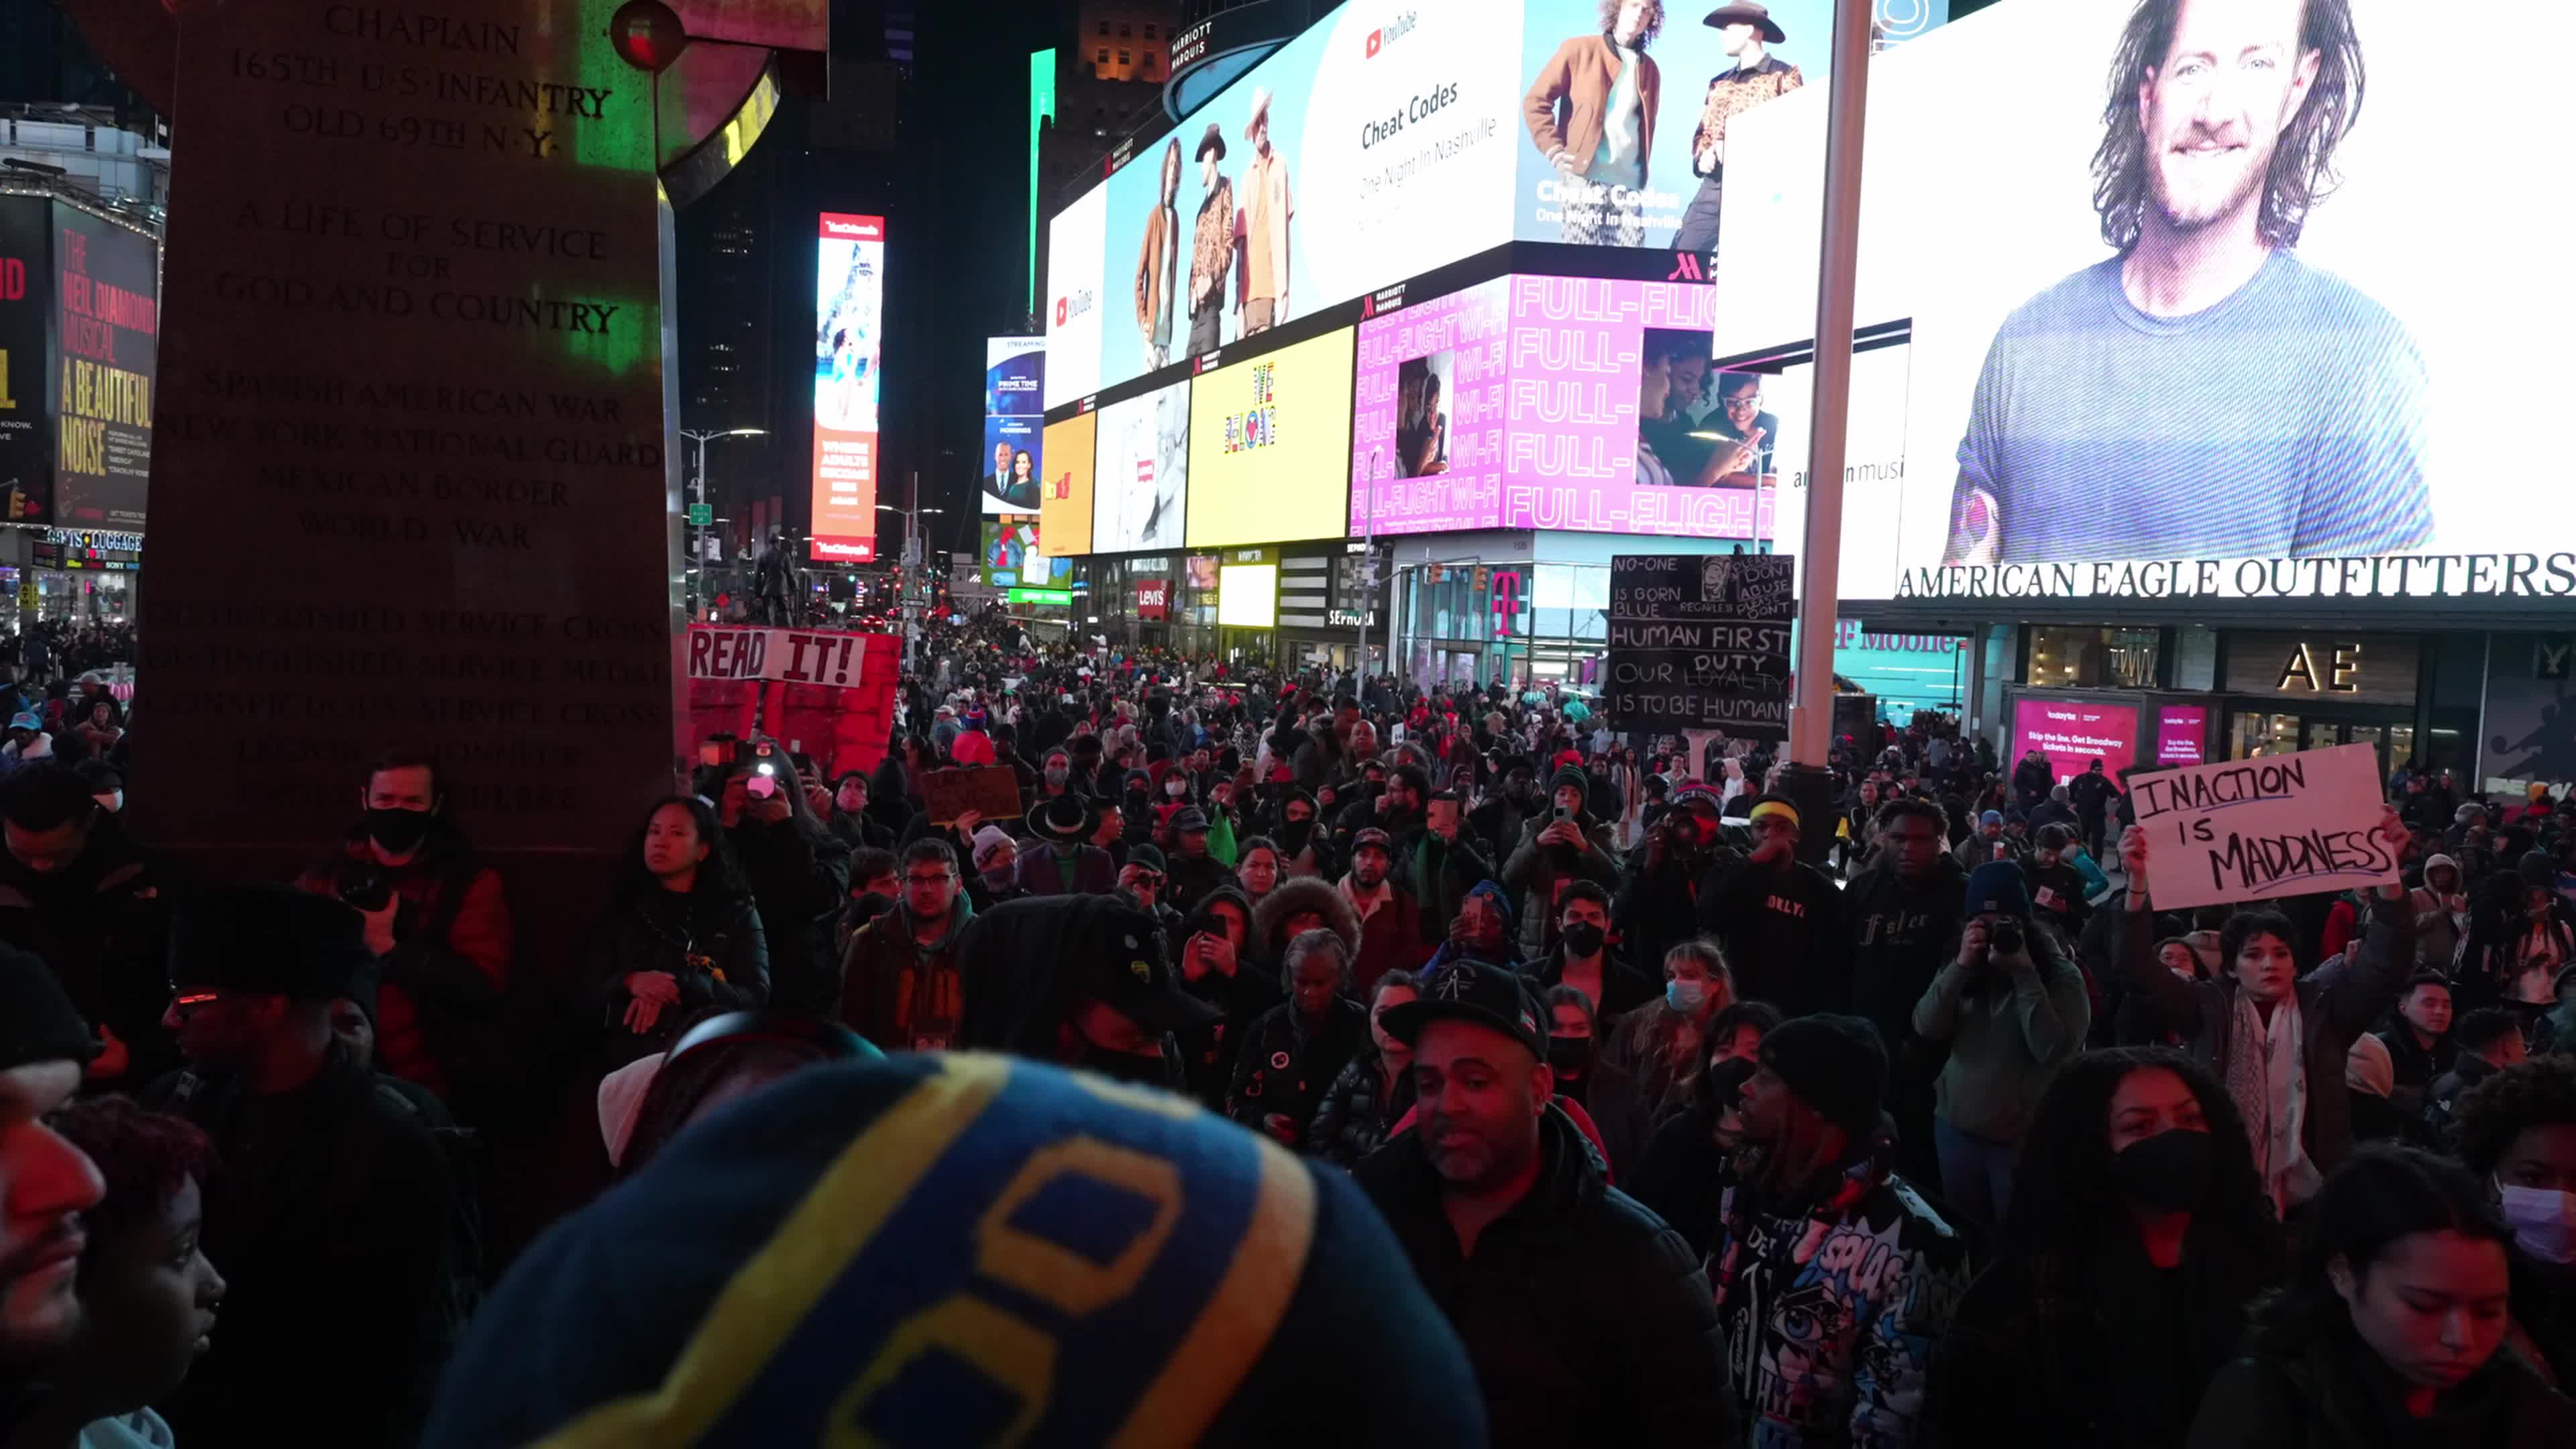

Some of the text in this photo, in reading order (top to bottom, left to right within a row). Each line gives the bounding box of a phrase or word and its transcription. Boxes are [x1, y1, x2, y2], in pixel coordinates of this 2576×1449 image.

[324, 4, 523, 56] CHAPLAIN
[1172, 21, 1212, 55] MARRIOTT
[1171, 42, 1205, 72] MARQUIS
[231, 48, 338, 85] 165TH
[437, 72, 612, 119] INFANTRY
[283, 104, 365, 138] OLD
[378, 113, 468, 149] 69TH
[1362, 82, 1457, 150] Cheat Codes
[1385, 157, 1416, 188] Night
[1435, 117, 1498, 164] Nashville
[1537, 180, 1680, 209] Cheat Codes
[64, 228, 87, 274] THE
[236, 199, 607, 260] A LIFE OF SERVICE
[385, 251, 453, 280] FOR
[64, 270, 156, 334] NEIL DIAMOND
[214, 271, 620, 334] GOD AND COUNTRY
[1515, 276, 1717, 327] FULL-FLI
[64, 310, 117, 364] MUSICAL
[62, 356, 151, 429] A BEAUTIFUL
[203, 369, 621, 424] SPANISH AMERICAN WAR
[61, 413, 105, 477] NOISE
[252, 419, 343, 449] YORK
[363, 424, 533, 463] NATIONAL
[544, 437, 662, 470] GUARD
[258, 462, 570, 508] MEXICAN BORDER
[91, 533, 142, 552] LUGGAGE
[299, 511, 533, 550] WORLD WAR
[1613, 557, 1678, 571] NO-ONE
[1898, 552, 2576, 598] AMERICAN EAGLE OUTFITTERS
[1491, 571, 1520, 636] T
[1613, 602, 1660, 617] BLUE
[1614, 587, 1680, 602] IS BORN
[418, 611, 547, 641] SERVICE
[562, 614, 664, 644] CROSS
[1611, 625, 1790, 653] HUMAN FIRST
[418, 653, 548, 683] SERVICE
[689, 631, 854, 684] READ IT!
[1615, 663, 1673, 683] OUR
[1695, 655, 1767, 672] DUTY
[561, 702, 664, 729] CROSS
[1616, 694, 1634, 712] IS
[1639, 695, 1665, 714] TO
[1670, 695, 1698, 715] BE
[2086, 736, 2123, 749] Broadway
[2135, 757, 2306, 819] INACTION
[2178, 818, 2214, 846] IS
[2208, 826, 2393, 891] MADDNESS
